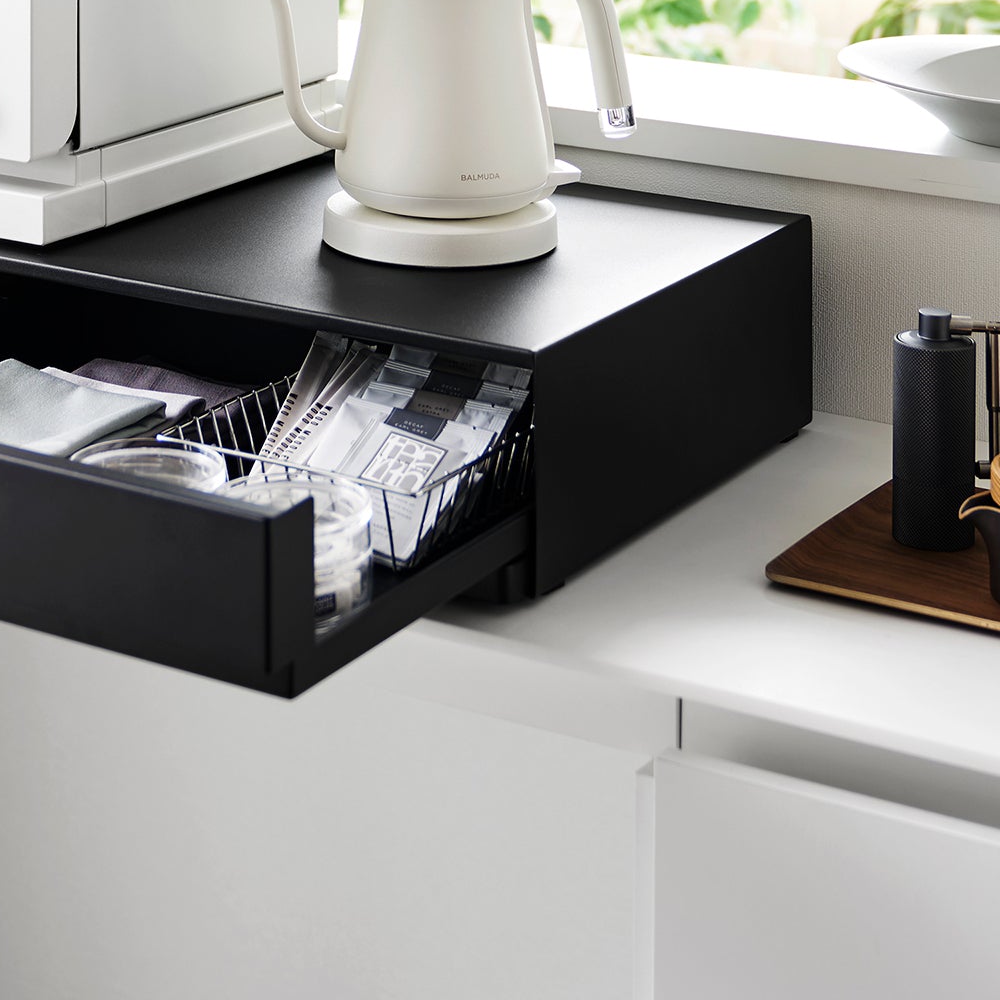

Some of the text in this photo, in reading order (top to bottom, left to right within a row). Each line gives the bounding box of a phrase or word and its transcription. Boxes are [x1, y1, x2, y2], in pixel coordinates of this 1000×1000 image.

[460, 173, 501, 182] BALMUDA
[281, 393, 298, 417] WOOD
[269, 401, 324, 459] WOOD MUDDLE
